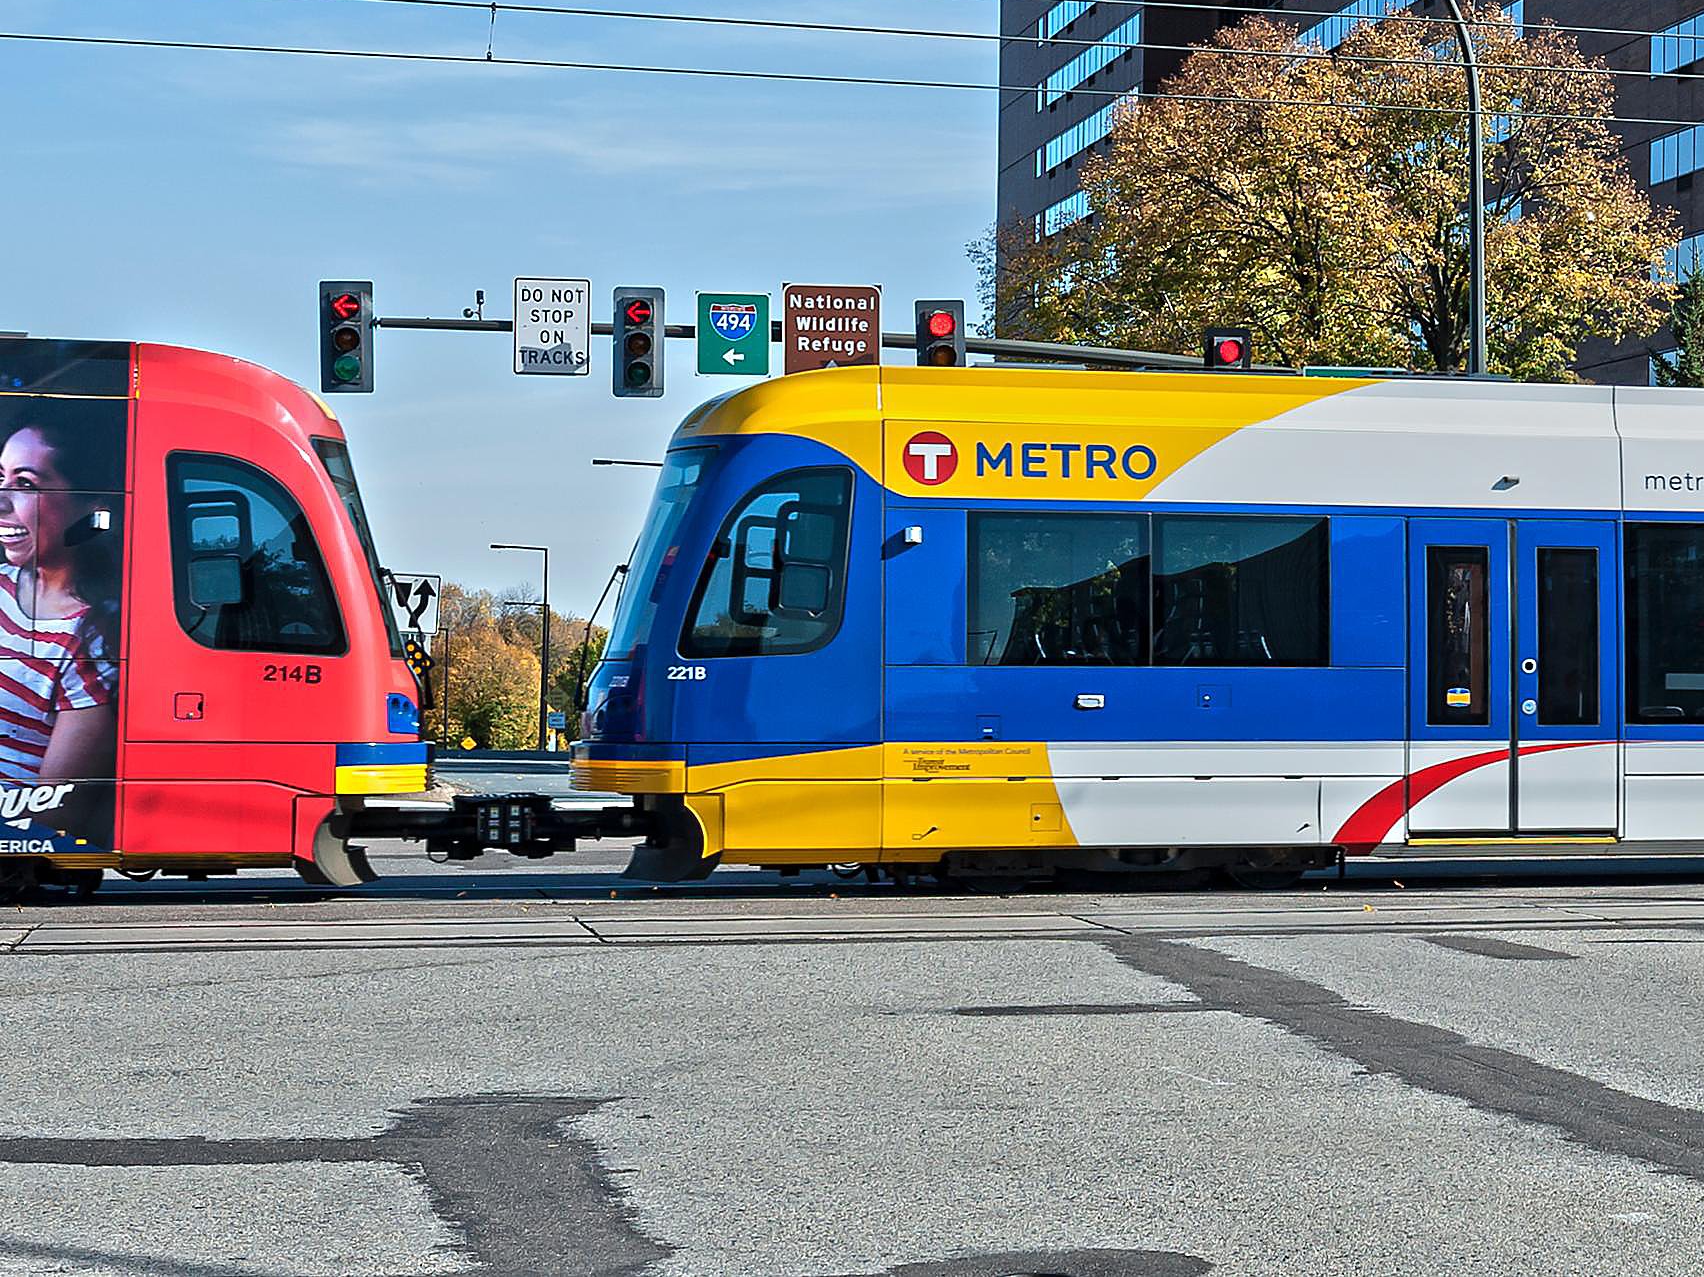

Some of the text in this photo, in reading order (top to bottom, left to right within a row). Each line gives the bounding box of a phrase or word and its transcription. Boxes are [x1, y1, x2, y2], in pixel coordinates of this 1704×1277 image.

[521, 288, 585, 304] DO NOT
[789, 294, 875, 311] National
[530, 309, 574, 324] STOP
[716, 314, 752, 332] 494
[796, 316, 870, 332] Wildlife
[540, 330, 564, 345] ON
[798, 336, 867, 357] Refuge
[519, 350, 585, 366] TRACKS
[976, 441, 1158, 481] METRO
[263, 665, 322, 684] 214B
[667, 666, 707, 681] 221B
[0, 839, 55, 853] ERICA
